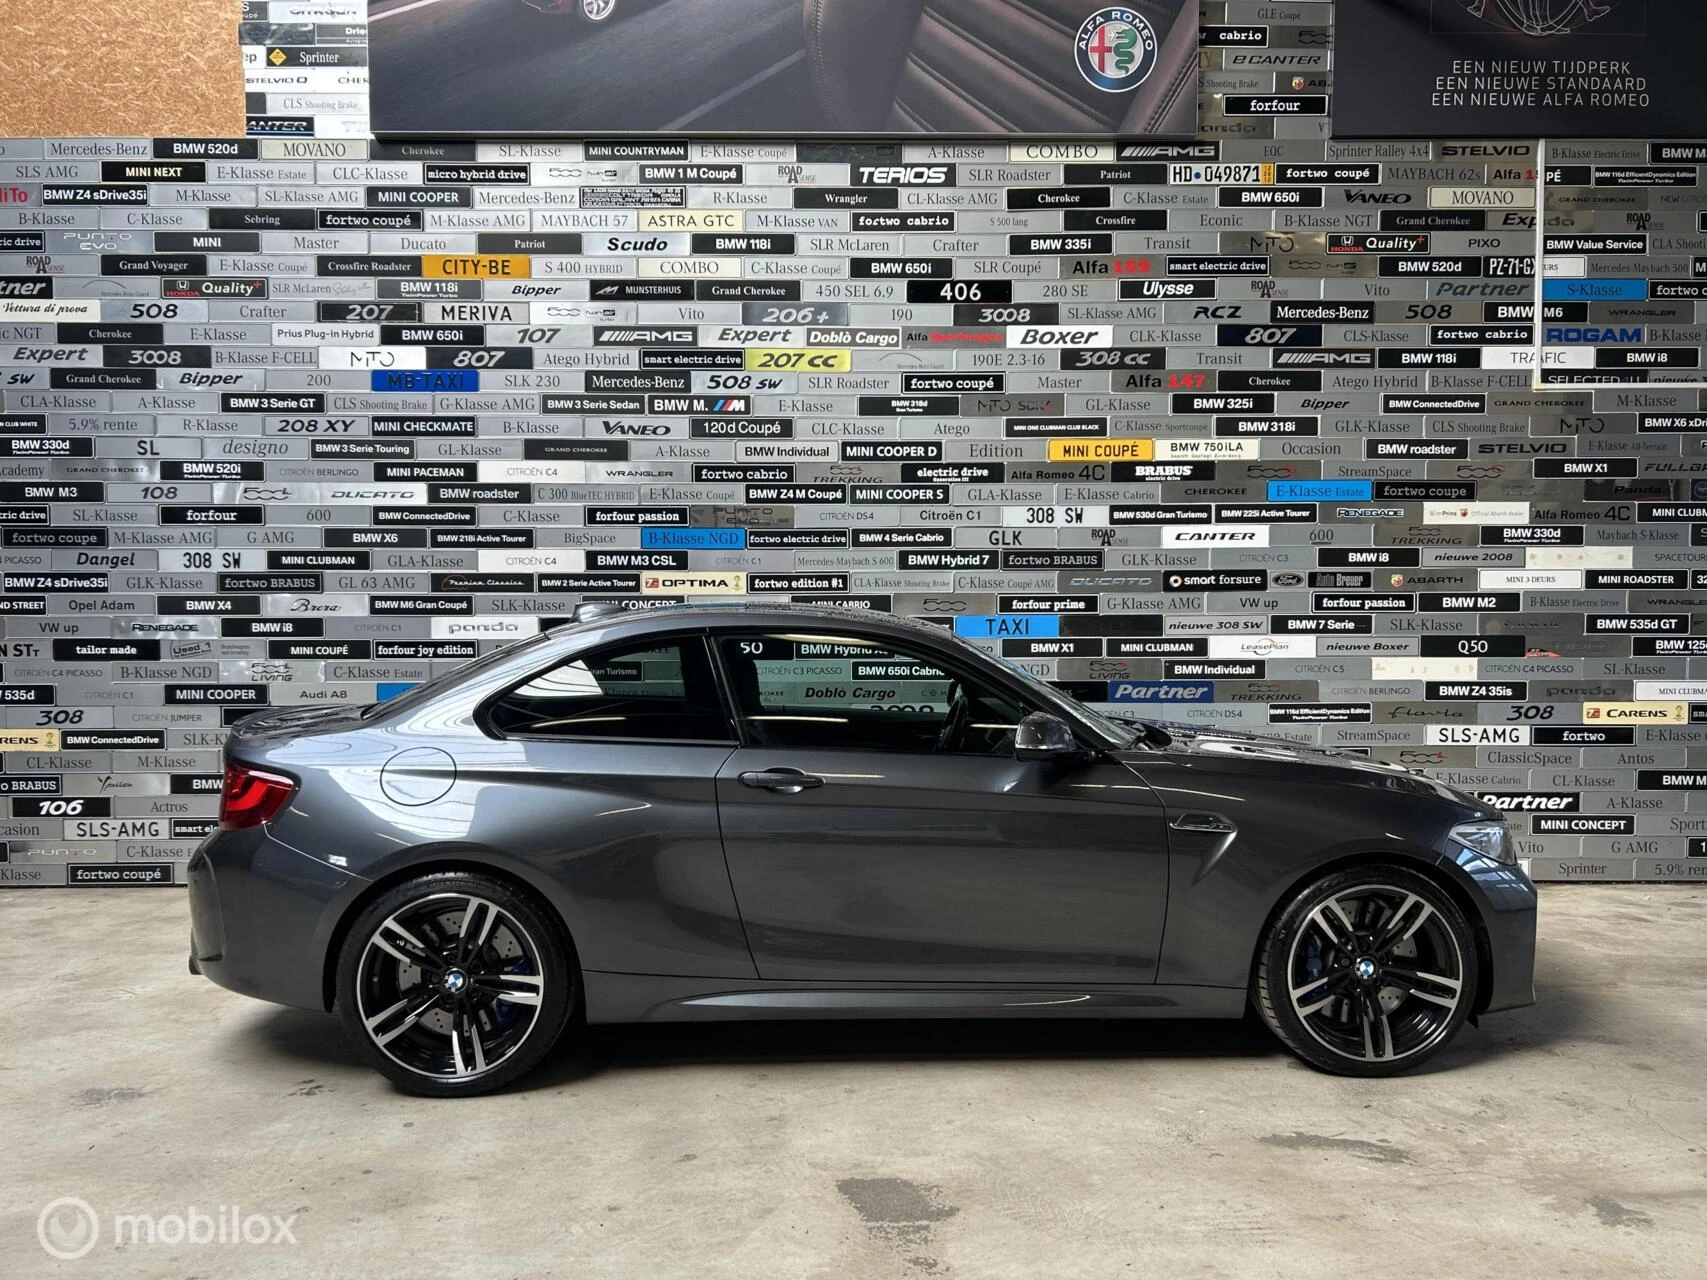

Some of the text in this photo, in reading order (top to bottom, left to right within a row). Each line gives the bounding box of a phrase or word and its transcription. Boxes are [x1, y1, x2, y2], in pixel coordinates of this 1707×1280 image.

[1079, 11, 1153, 50] ALFA ROMEO
[299, 52, 339, 63] Sprinter
[1453, 61, 1629, 74] EEN NIEUW TIJDPERK
[1437, 77, 1645, 90] EEN NIEUWE STANDAARD
[284, 98, 357, 111] CLS Shooting Brake
[1251, 100, 1300, 110] forfour
[1432, 93, 1650, 107] EEN NIEUWE ALFA ROMEO
[51, 143, 146, 155] Mercedes-Benz
[174, 143, 238, 154] BMW 520d
[284, 143, 345, 156] MOVANO
[589, 146, 684, 155] MINI COUNTRYMAN
[928, 146, 984, 159] A-Klasse
[1026, 145, 1098, 158] COMBO
[1440, 146, 1529, 156] STELVIO
[16, 166, 78, 177] SLS AMG
[126, 167, 182, 176] MINI NEXT
[333, 168, 407, 179] CLC-Klasse
[428, 169, 526, 180] micro hybrid drive
[645, 168, 736, 180] BMW 1 M Coupé
[859, 167, 947, 183] TERIOS
[969, 169, 1051, 180] SLR Roadster
[1101, 169, 1130, 178] Patriot
[176, 190, 230, 201] M-Klasse
[1038, 194, 1080, 203] Cherokee
[1344, 190, 1411, 203] VANEO
[1453, 191, 1513, 204] MOVANO
[19, 213, 74, 224] B-Klasse
[245, 215, 280, 225] Sebring
[326, 211, 411, 229] fortwo coupé
[648, 215, 734, 226] ASTRA GTC
[859, 216, 949, 225] fortwo cabrio
[1201, 214, 1242, 226] Econic
[608, 238, 667, 251] Scudo
[1145, 238, 1190, 249] Transit
[1469, 238, 1500, 247] PIXO
[1547, 239, 1643, 249] BMW Value Service
[120, 260, 188, 271] Grand Voyager
[443, 260, 510, 275] CITY-BE
[660, 262, 718, 273] COMBO
[1170, 261, 1266, 271] smart electric drive
[626, 285, 681, 294] MUNSTERHUIS
[941, 283, 981, 300] 406
[1143, 282, 1194, 296] Ulysse
[1436, 283, 1530, 296] Partner
[1568, 284, 1622, 295] S-Klasse
[44, 303, 57, 312] di
[56, 305, 88, 316] prova
[130, 304, 177, 318] 508
[442, 306, 512, 320] MERIVA
[979, 308, 1030, 322] 3008
[1277, 306, 1368, 318] Mercedes-Benz
[278, 328, 374, 340] Prius Plug-in Hybrid
[518, 329, 561, 343] 107
[718, 328, 792, 343] Expert
[1020, 329, 1098, 344] Boxer
[1547, 328, 1641, 342] ROGAM
[128, 350, 181, 364] 3008
[1402, 353, 1456, 363] BMW 118i
[179, 373, 243, 386] Bipper
[1126, 374, 1205, 388] Alfa 147
[278, 420, 355, 432] 208 XY
[704, 421, 781, 436] 120d Coupé
[1336, 421, 1409, 432] GLK-Klasse
[138, 438, 160, 456] SL
[223, 440, 289, 458] designo
[847, 447, 937, 456] MINI COOPER D
[1064, 439, 1139, 457] MINI COUPÉ
[1282, 443, 1340, 454] Occasion
[1135, 466, 1193, 475] BRABUS
[1564, 463, 1607, 472] BMW X1
[606, 470, 673, 478] WRANGLER
[25, 487, 77, 497] BMW M3
[440, 489, 519, 498] BMW roadster
[187, 510, 237, 520] forfour
[920, 510, 980, 520] Citroën C1
[565, 533, 615, 544] BigSpace
[989, 531, 1022, 545] GLK
[1176, 532, 1255, 541] CANTER
[77, 553, 134, 568] Dangel
[598, 555, 676, 565] BMW M3 CSL
[1482, 553, 1512, 561] 2008
[662, 579, 728, 588] OPTIMA
[755, 575, 843, 590] fortwo edition #1
[1184, 575, 1261, 584] smart forsure
[1599, 575, 1674, 584] MINI ROADSTER
[69, 600, 134, 612] Opel Adam
[986, 619, 1028, 635] TAXI
[1458, 640, 1488, 654] Q50
[300, 690, 347, 699] Audi A8
[1115, 682, 1207, 701] Partner
[1607, 708, 1667, 717] CARENS
[1439, 728, 1519, 742] SLS-AMG
[40, 800, 83, 816] 106
[1541, 820, 1626, 829] MINI CONCEPT
[77, 866, 161, 883] fortwo coupé
[1559, 863, 1607, 874] Sprinter
